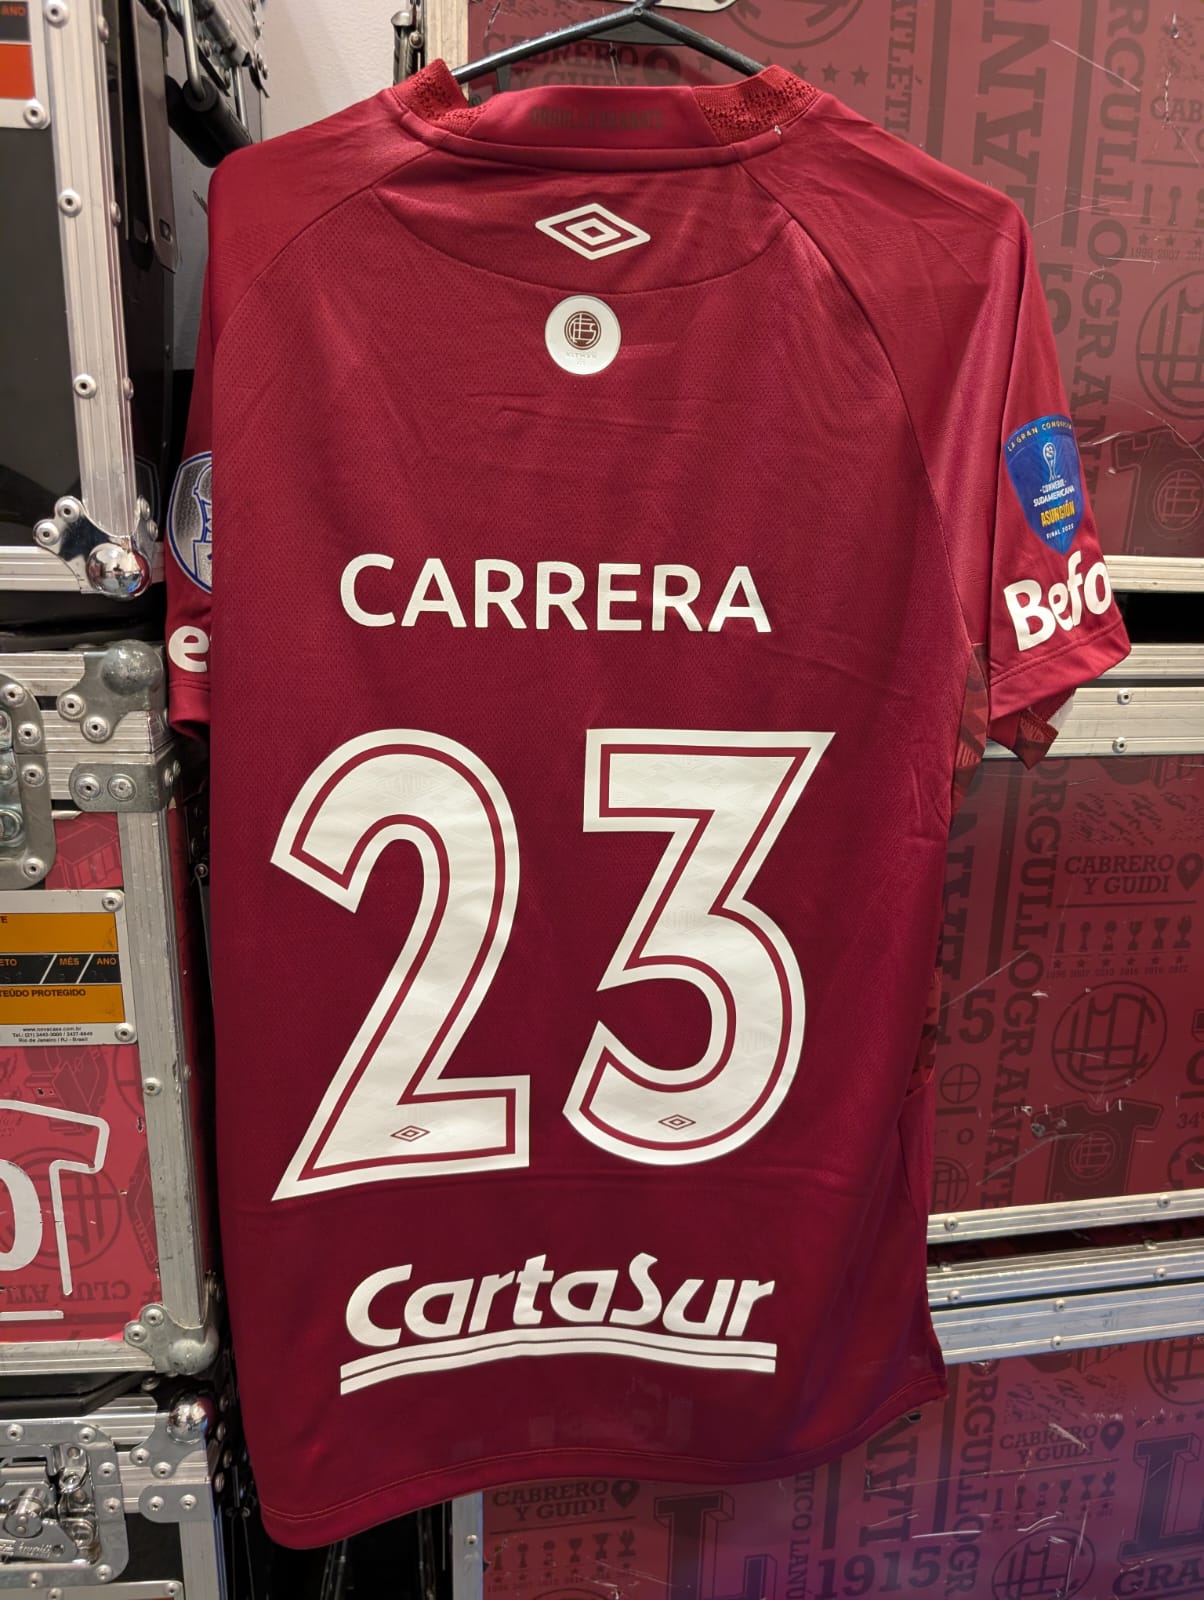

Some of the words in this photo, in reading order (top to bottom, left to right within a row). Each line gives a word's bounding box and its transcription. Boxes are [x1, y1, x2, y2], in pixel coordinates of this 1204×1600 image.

[341, 554, 771, 632] CARRERA
[1003, 551, 1112, 651] Befo
[1064, 854, 1174, 875] CABRERO
[1083, 876, 1099, 895] Y
[1103, 875, 1171, 895] GUIDI
[59, 956, 80, 966] MÊS
[96, 957, 117, 966] ANO
[270, 728, 835, 1201] 23
[32, 988, 87, 997] PROTEGIDO
[346, 1253, 776, 1346] CartaSur
[493, 1480, 609, 1506] CABRERO
[515, 1505, 529, 1521] Y
[537, 1499, 606, 1519] GUIDI
[815, 1546, 942, 1600] 1915
